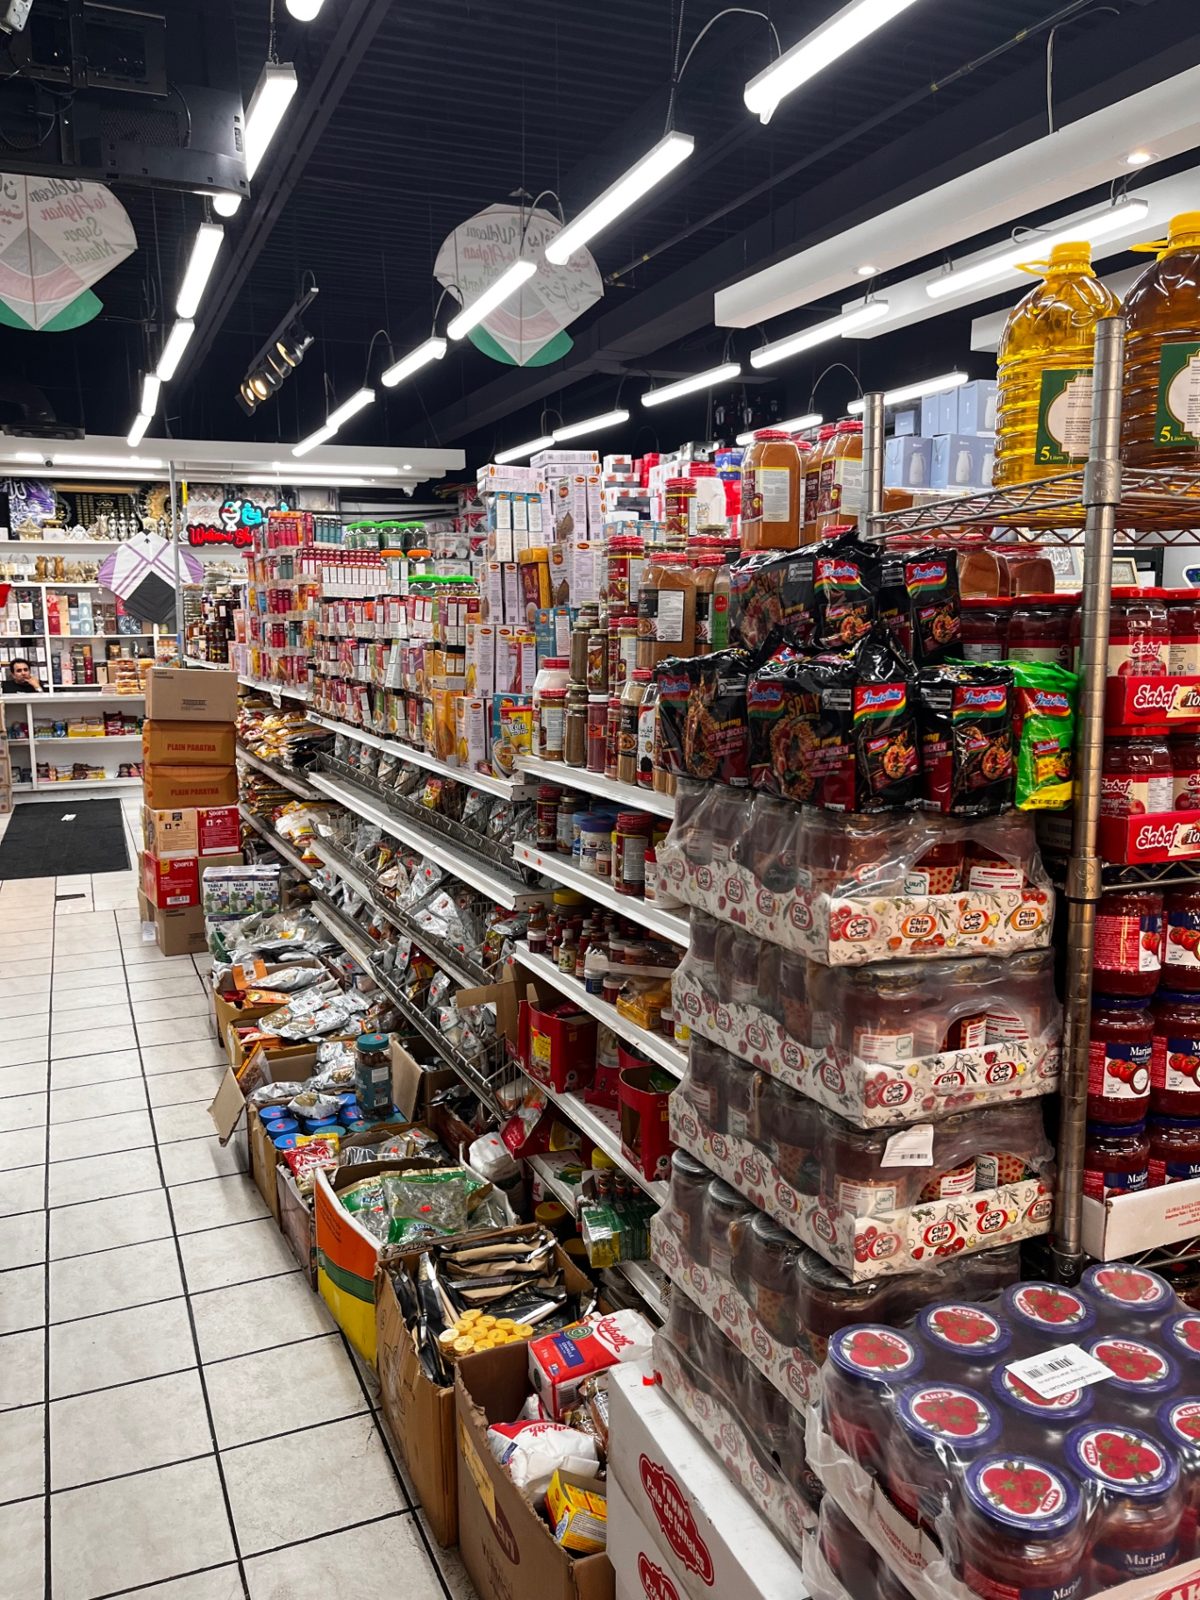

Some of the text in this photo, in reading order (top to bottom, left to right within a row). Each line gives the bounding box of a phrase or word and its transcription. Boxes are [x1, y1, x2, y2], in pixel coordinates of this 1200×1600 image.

[1160, 426, 1172, 443] 5
[1039, 446, 1051, 461] 5
[912, 564, 944, 579] Indomie
[1131, 640, 1163, 656] Sadaf
[863, 687, 903, 706] Indomie
[960, 687, 1003, 704] Indomie
[1034, 693, 1069, 708] Indomie
[1134, 684, 1181, 712] Sadaf
[167, 743, 216, 752] PLAIN PARATHA
[171, 788, 189, 796] PLAIN
[1136, 822, 1182, 850] Sadaf
[910, 917, 929, 926] Chin
[1018, 918, 1036, 926] Chin
[1019, 910, 1036, 919] Chin
[909, 925, 928, 934] Chin
[941, 1076, 958, 1084] Chin
[931, 1234, 948, 1242] Chin
[932, 1226, 949, 1235] Chin
[955, 1309, 980, 1319] AKFA
[597, 1317, 635, 1353] Redpath
[882, 1334, 904, 1349] AKFA
[1116, 1343, 1145, 1353] AKFA
[924, 1392, 951, 1400] AKFA
[1086, 1443, 1096, 1463] AKFA
[1041, 1491, 1059, 1511] AKFA
[664, 1502, 674, 1520] de
[1125, 1552, 1166, 1566] Marjan
